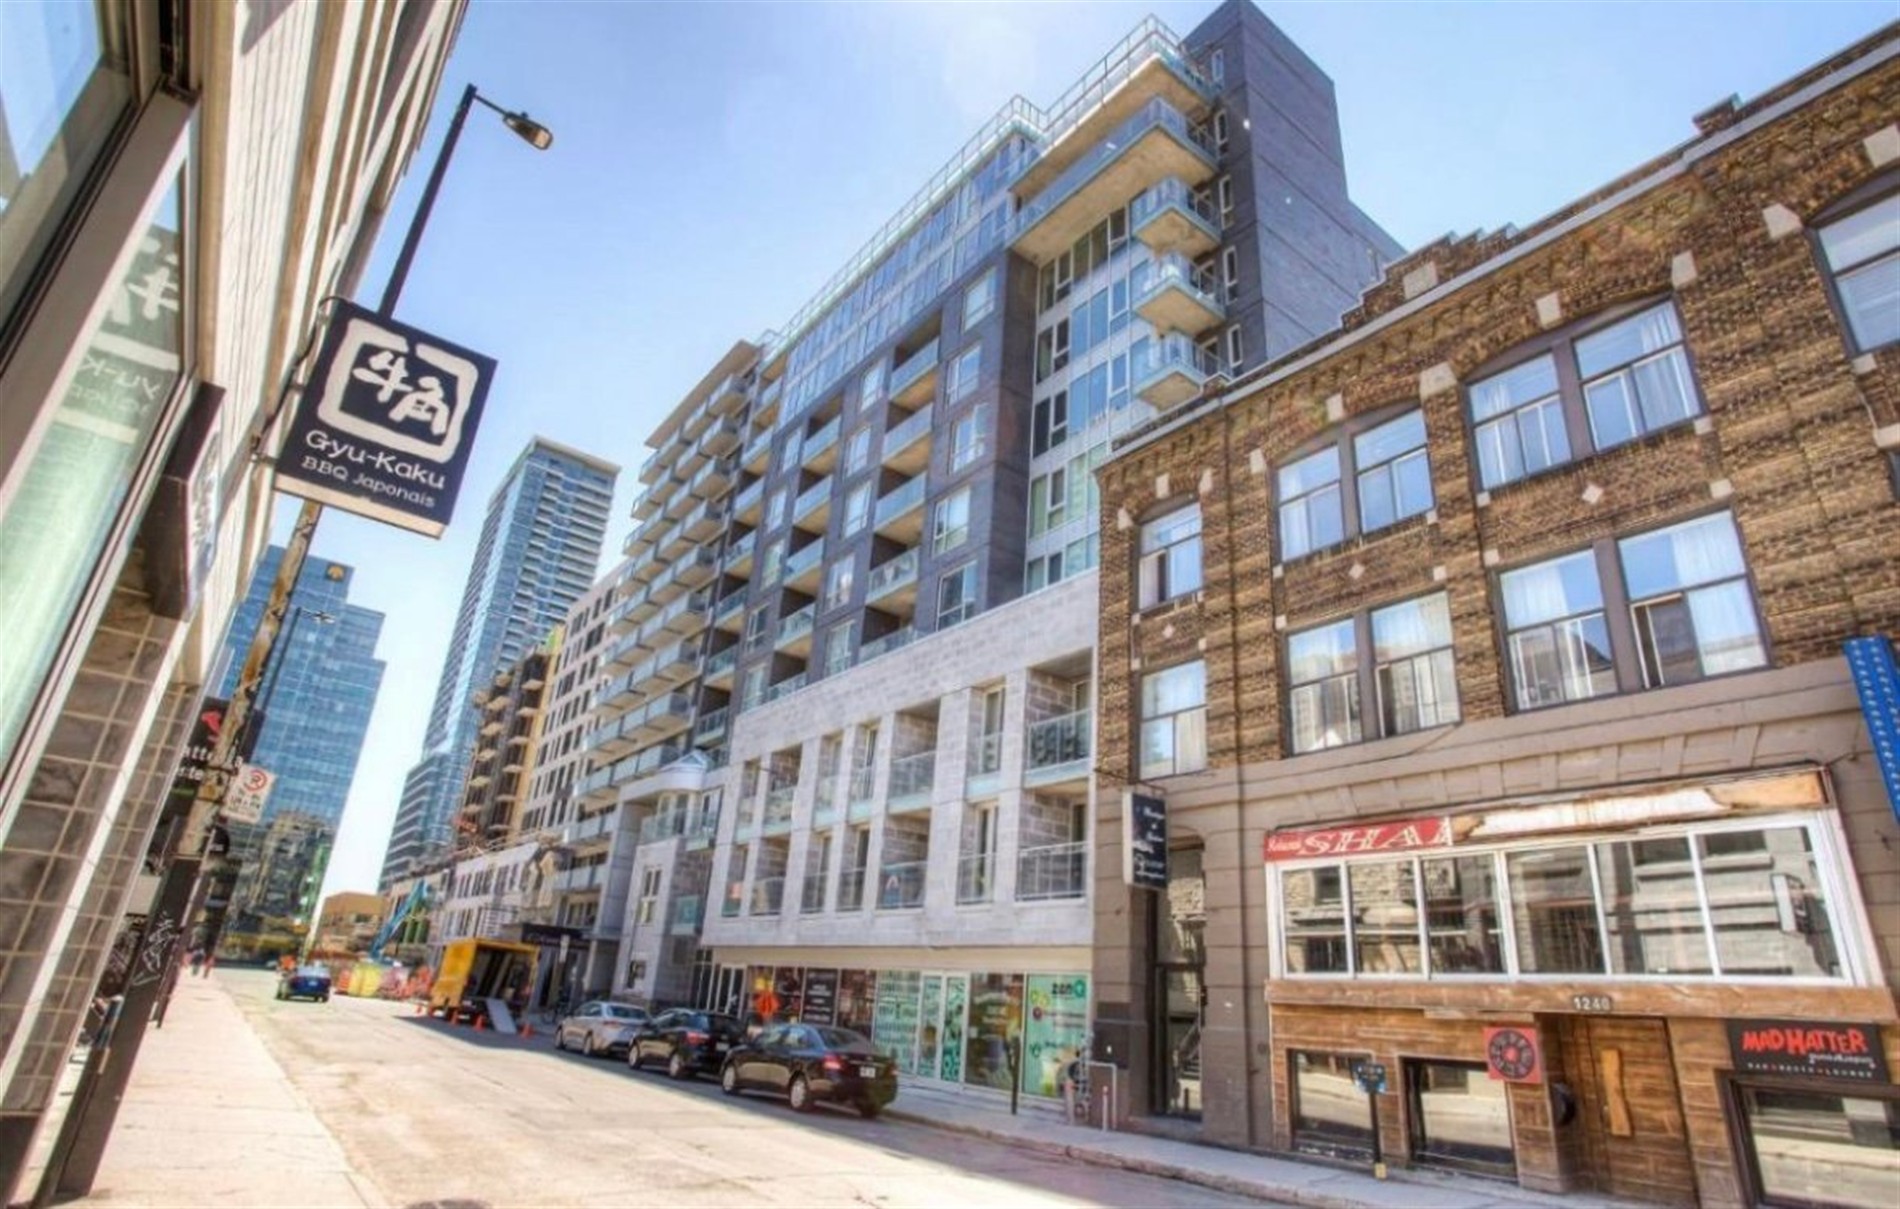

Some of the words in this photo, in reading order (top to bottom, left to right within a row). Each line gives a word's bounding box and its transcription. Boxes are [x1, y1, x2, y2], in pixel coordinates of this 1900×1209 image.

[352, 350, 450, 436] 牛角
[301, 456, 349, 482] BBQ
[352, 473, 436, 509] Japonais
[305, 430, 446, 490] Gyu-Kaku
[1742, 1029, 1785, 1053] MAD
[1785, 1028, 1870, 1055] HATTER
